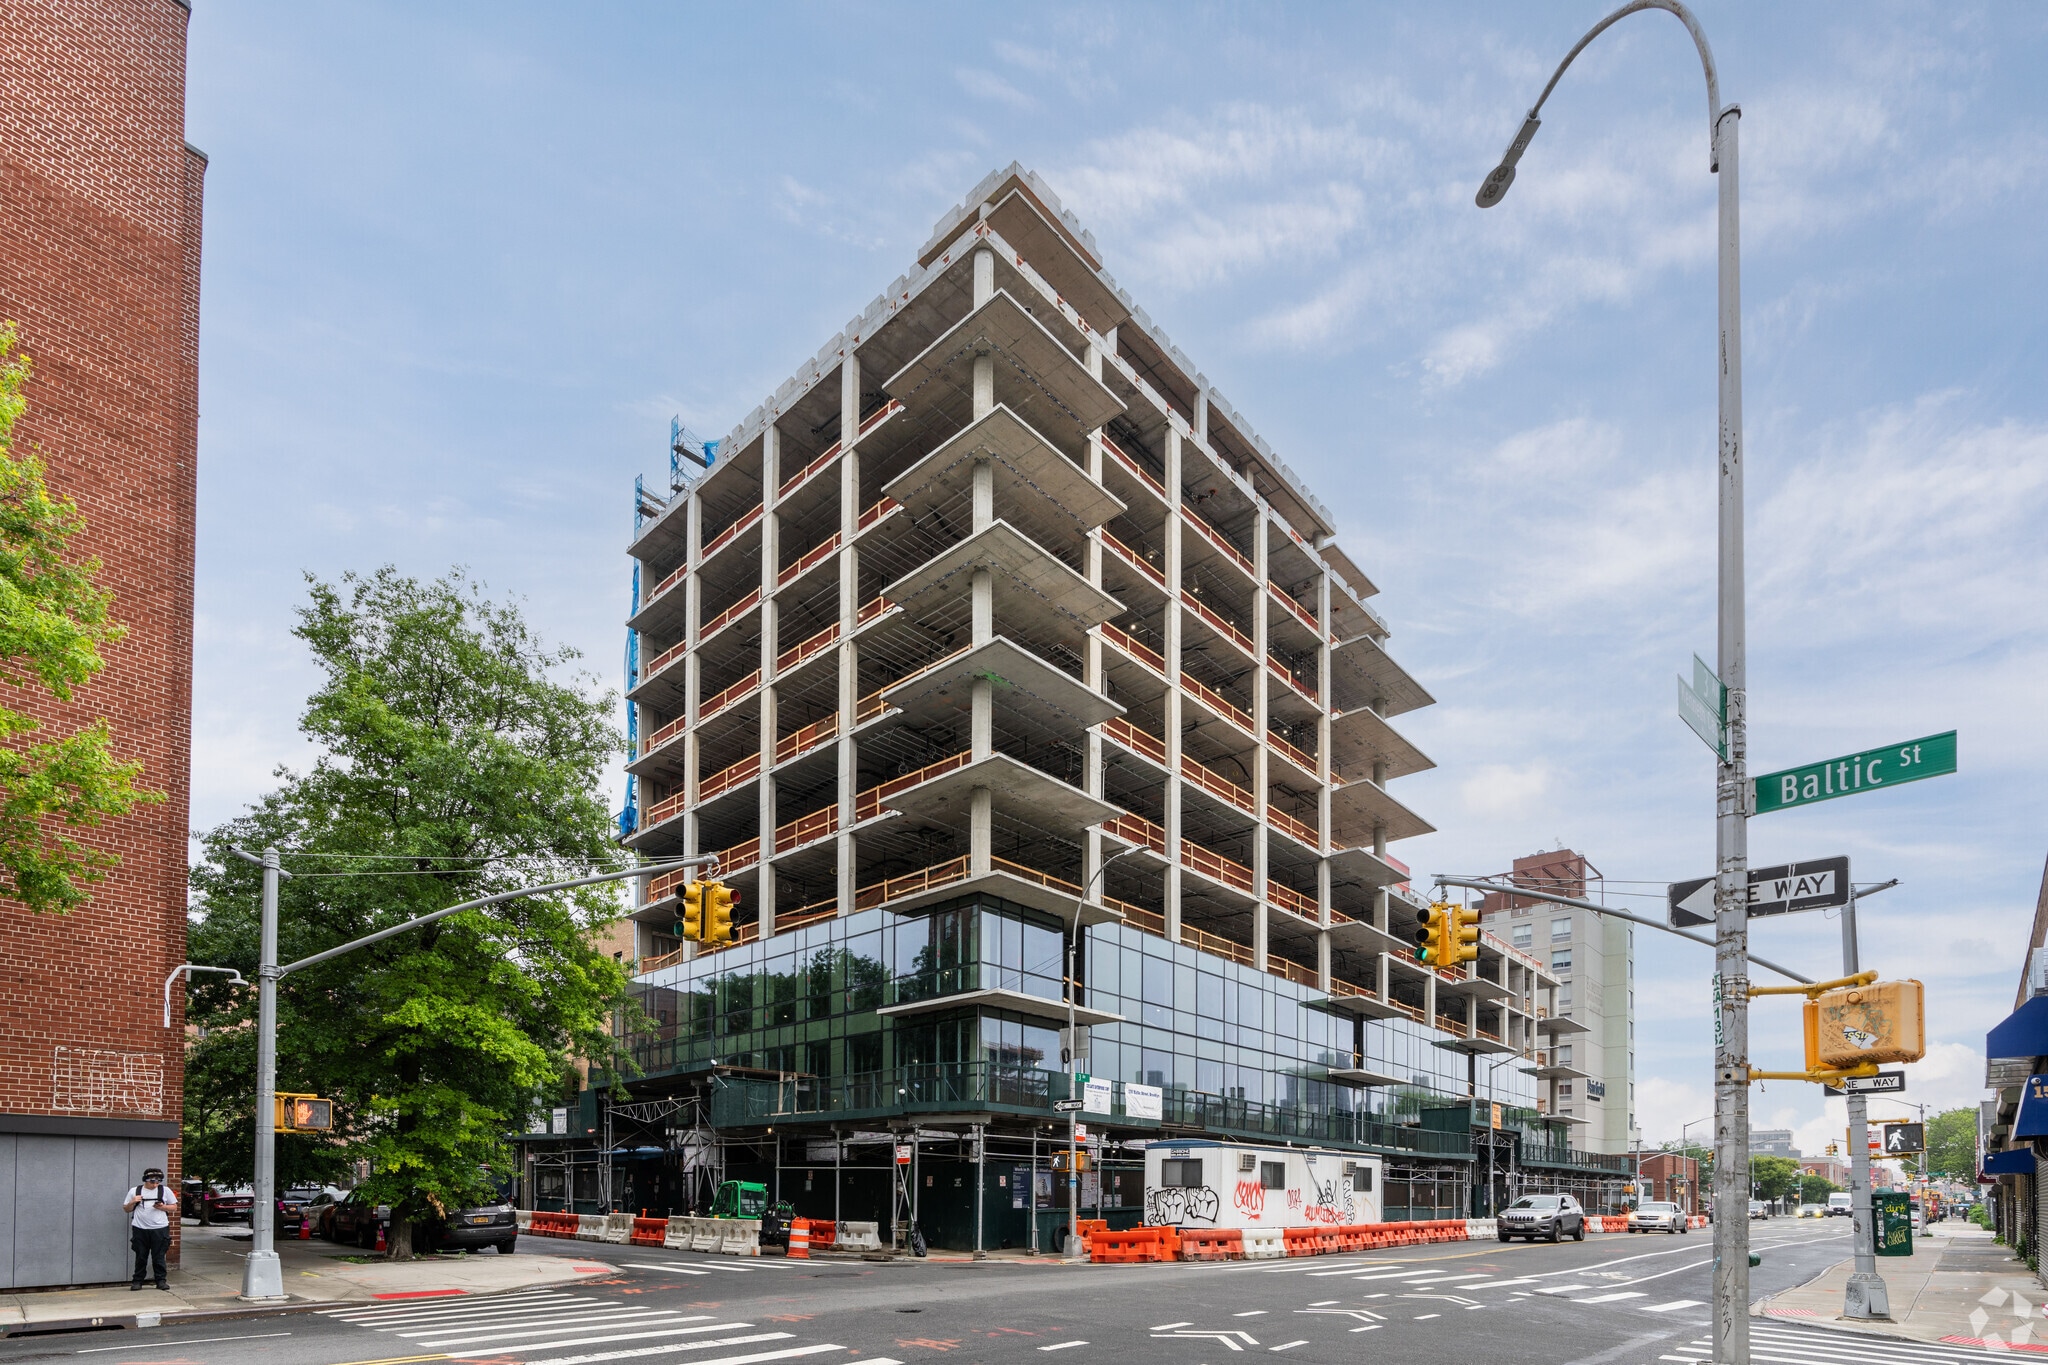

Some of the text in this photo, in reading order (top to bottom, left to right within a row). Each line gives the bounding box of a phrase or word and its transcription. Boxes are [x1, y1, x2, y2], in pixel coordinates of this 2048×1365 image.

[1780, 744, 1921, 804] Baltic St
[1774, 873, 1828, 899] WAY
[1843, 1077, 1896, 1089] NE WAY
